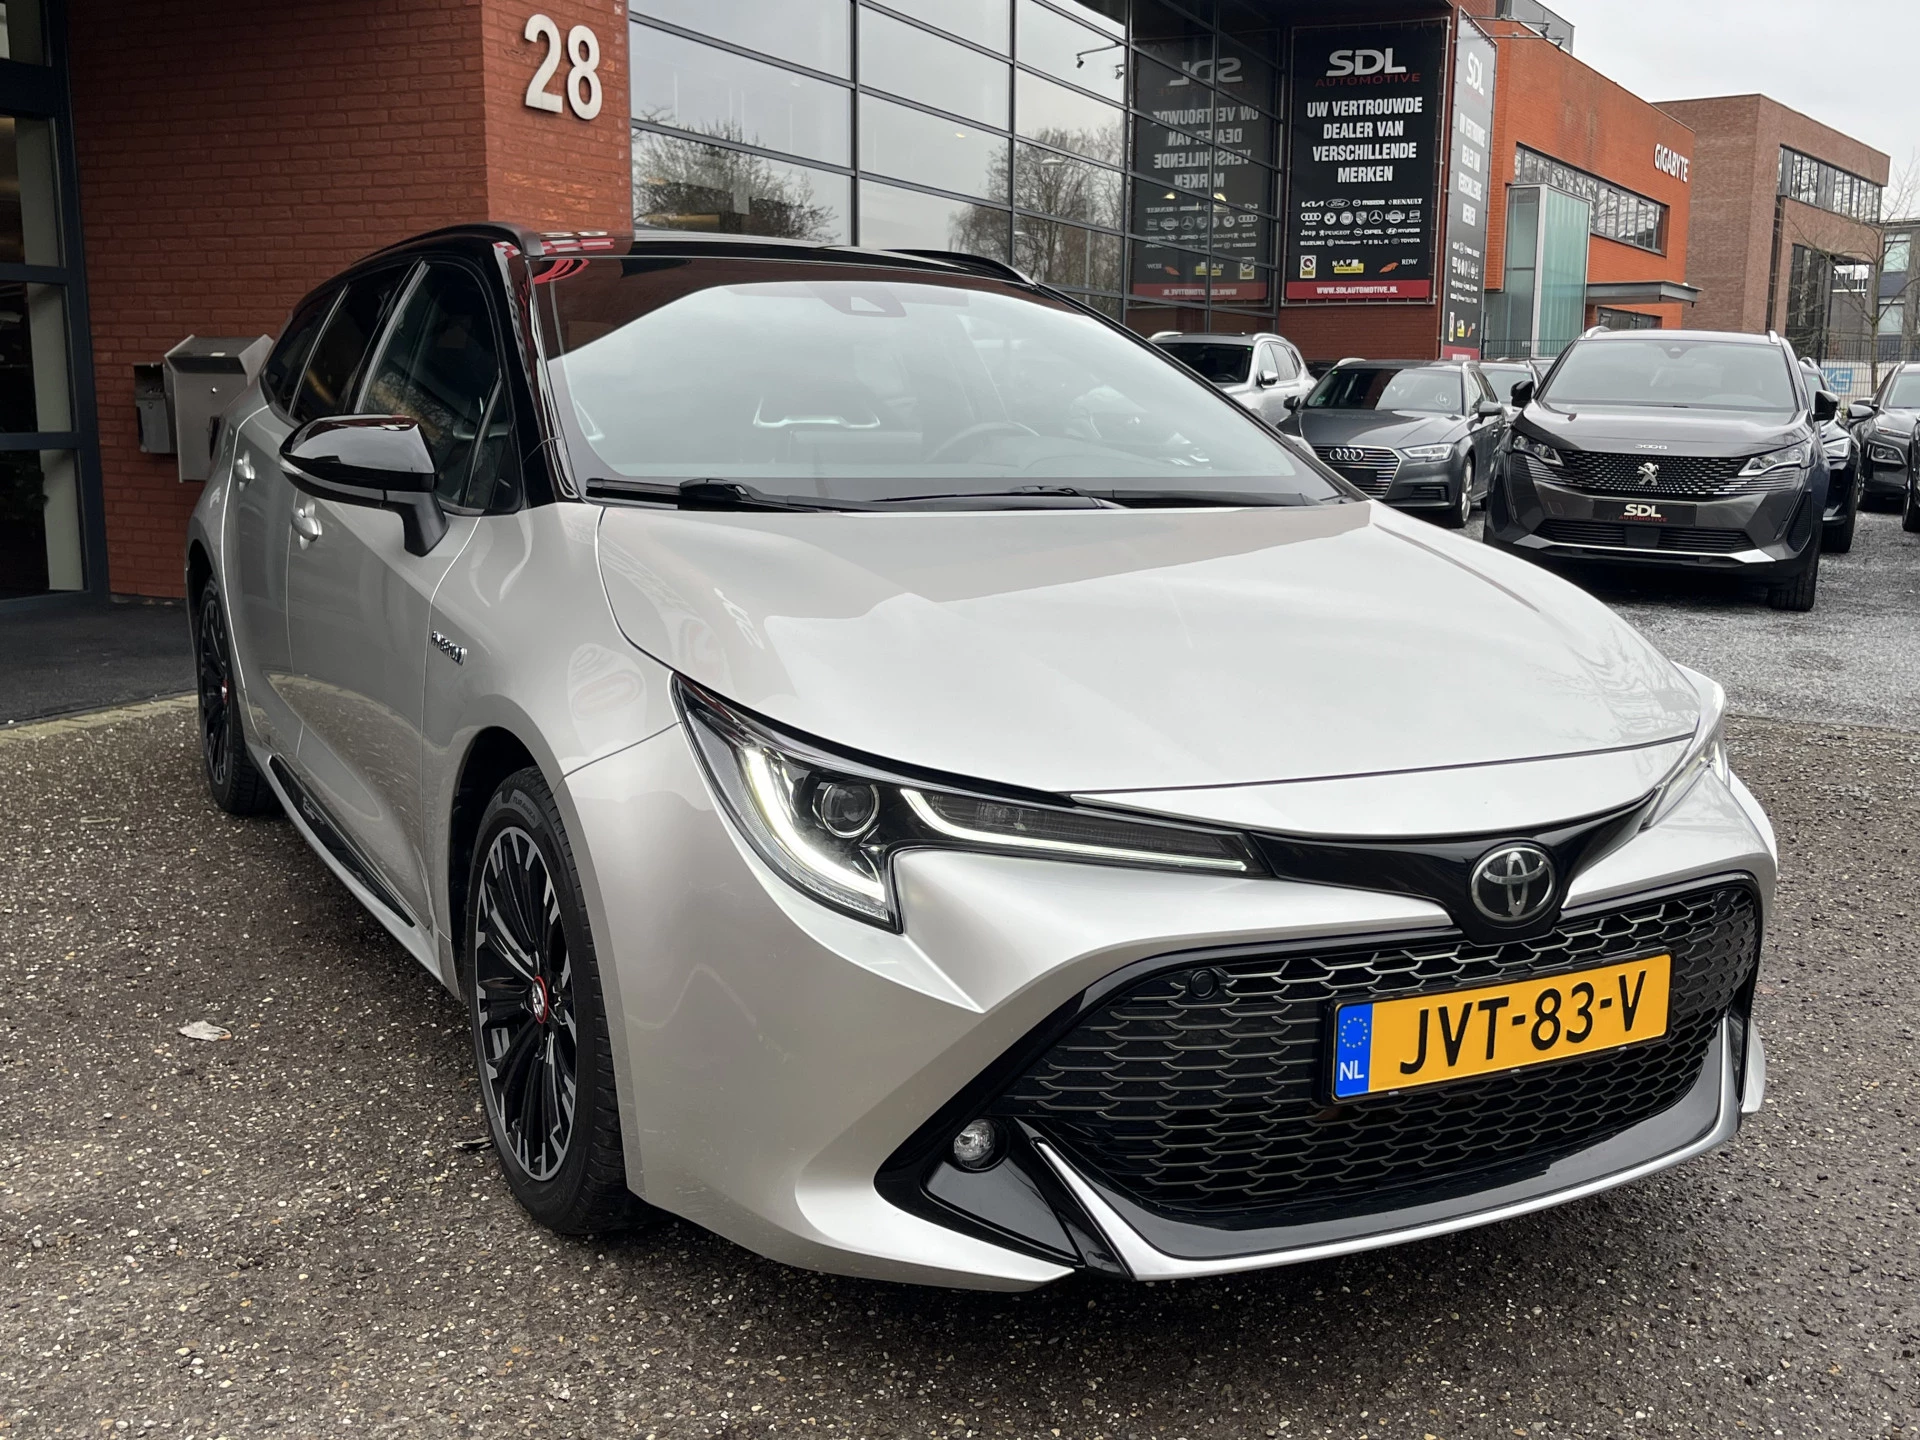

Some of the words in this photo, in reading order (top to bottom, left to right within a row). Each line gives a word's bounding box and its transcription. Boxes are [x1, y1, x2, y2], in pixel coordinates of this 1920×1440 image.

[524, 13, 603, 120] 28
[1326, 47, 1407, 77] SDL
[1315, 73, 1421, 87] AUTOMOTIVE
[1466, 51, 1485, 96] SDL
[1307, 101, 1329, 118] UW
[1332, 97, 1423, 117] VERTROUWDE
[1323, 122, 1373, 139] DEALER
[1377, 120, 1404, 137] VAN
[1312, 142, 1417, 162] VERSCHILLENDE
[1654, 143, 1689, 183] GIGABYTE
[1337, 165, 1393, 183] MERKEN
[1316, 286, 1398, 294] WWW.SDLAUTOMOTIVE.NL
[1619, 515, 1668, 523] AUTOMOTIVE
[1624, 503, 1661, 518] SDL
[1400, 970, 1647, 1075] JVT-83-V
[1340, 1060, 1364, 1081] NL
